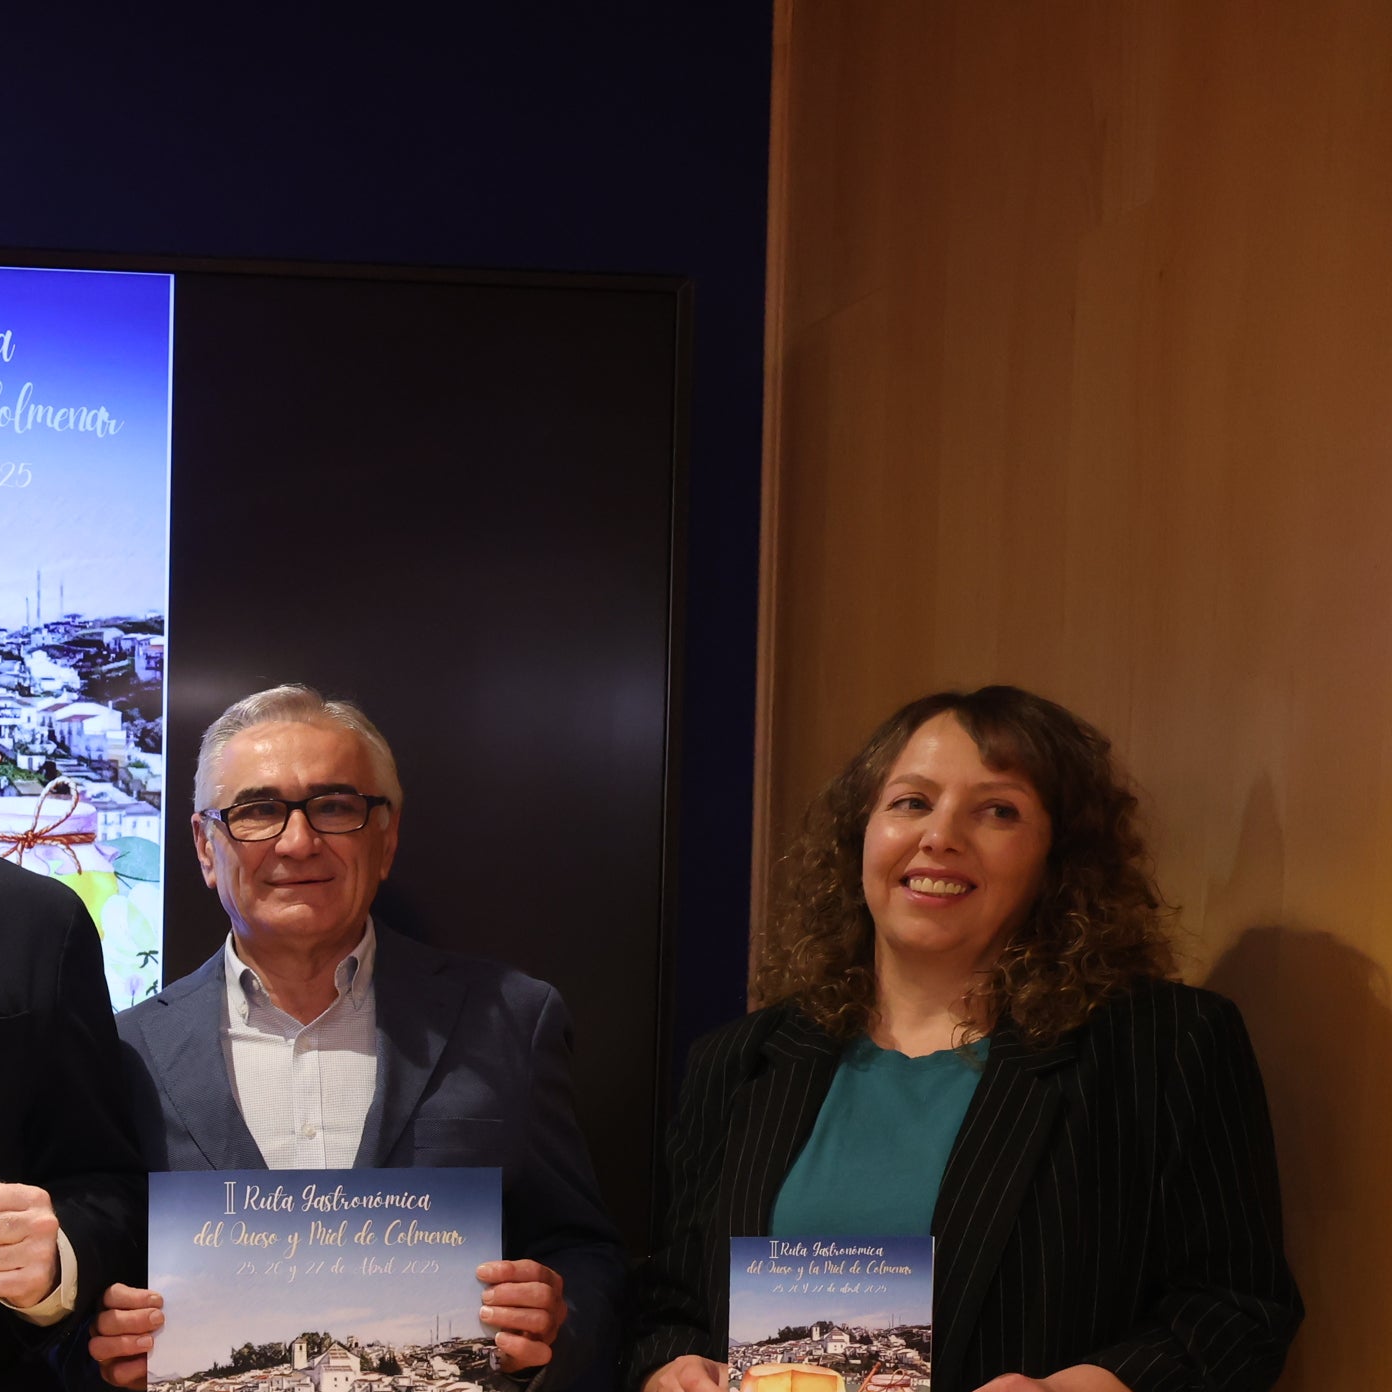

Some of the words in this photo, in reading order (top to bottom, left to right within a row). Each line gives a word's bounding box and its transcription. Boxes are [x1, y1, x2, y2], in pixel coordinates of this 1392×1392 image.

[243, 1184, 295, 1213] Ruta
[301, 1184, 432, 1213] Gastronómica
[193, 1221, 224, 1248] del
[283, 1231, 301, 1259] y
[308, 1220, 347, 1248] Miel
[354, 1220, 377, 1247] de
[383, 1219, 466, 1247] Colmenar
[780, 1241, 808, 1257] Ruta
[287, 1265, 297, 1283] y
[330, 1257, 345, 1274] de
[746, 1260, 763, 1275] del
[795, 1266, 804, 1281] y
[808, 1260, 821, 1275] la
[823, 1260, 846, 1275] Miel
[848, 1260, 862, 1275] de
